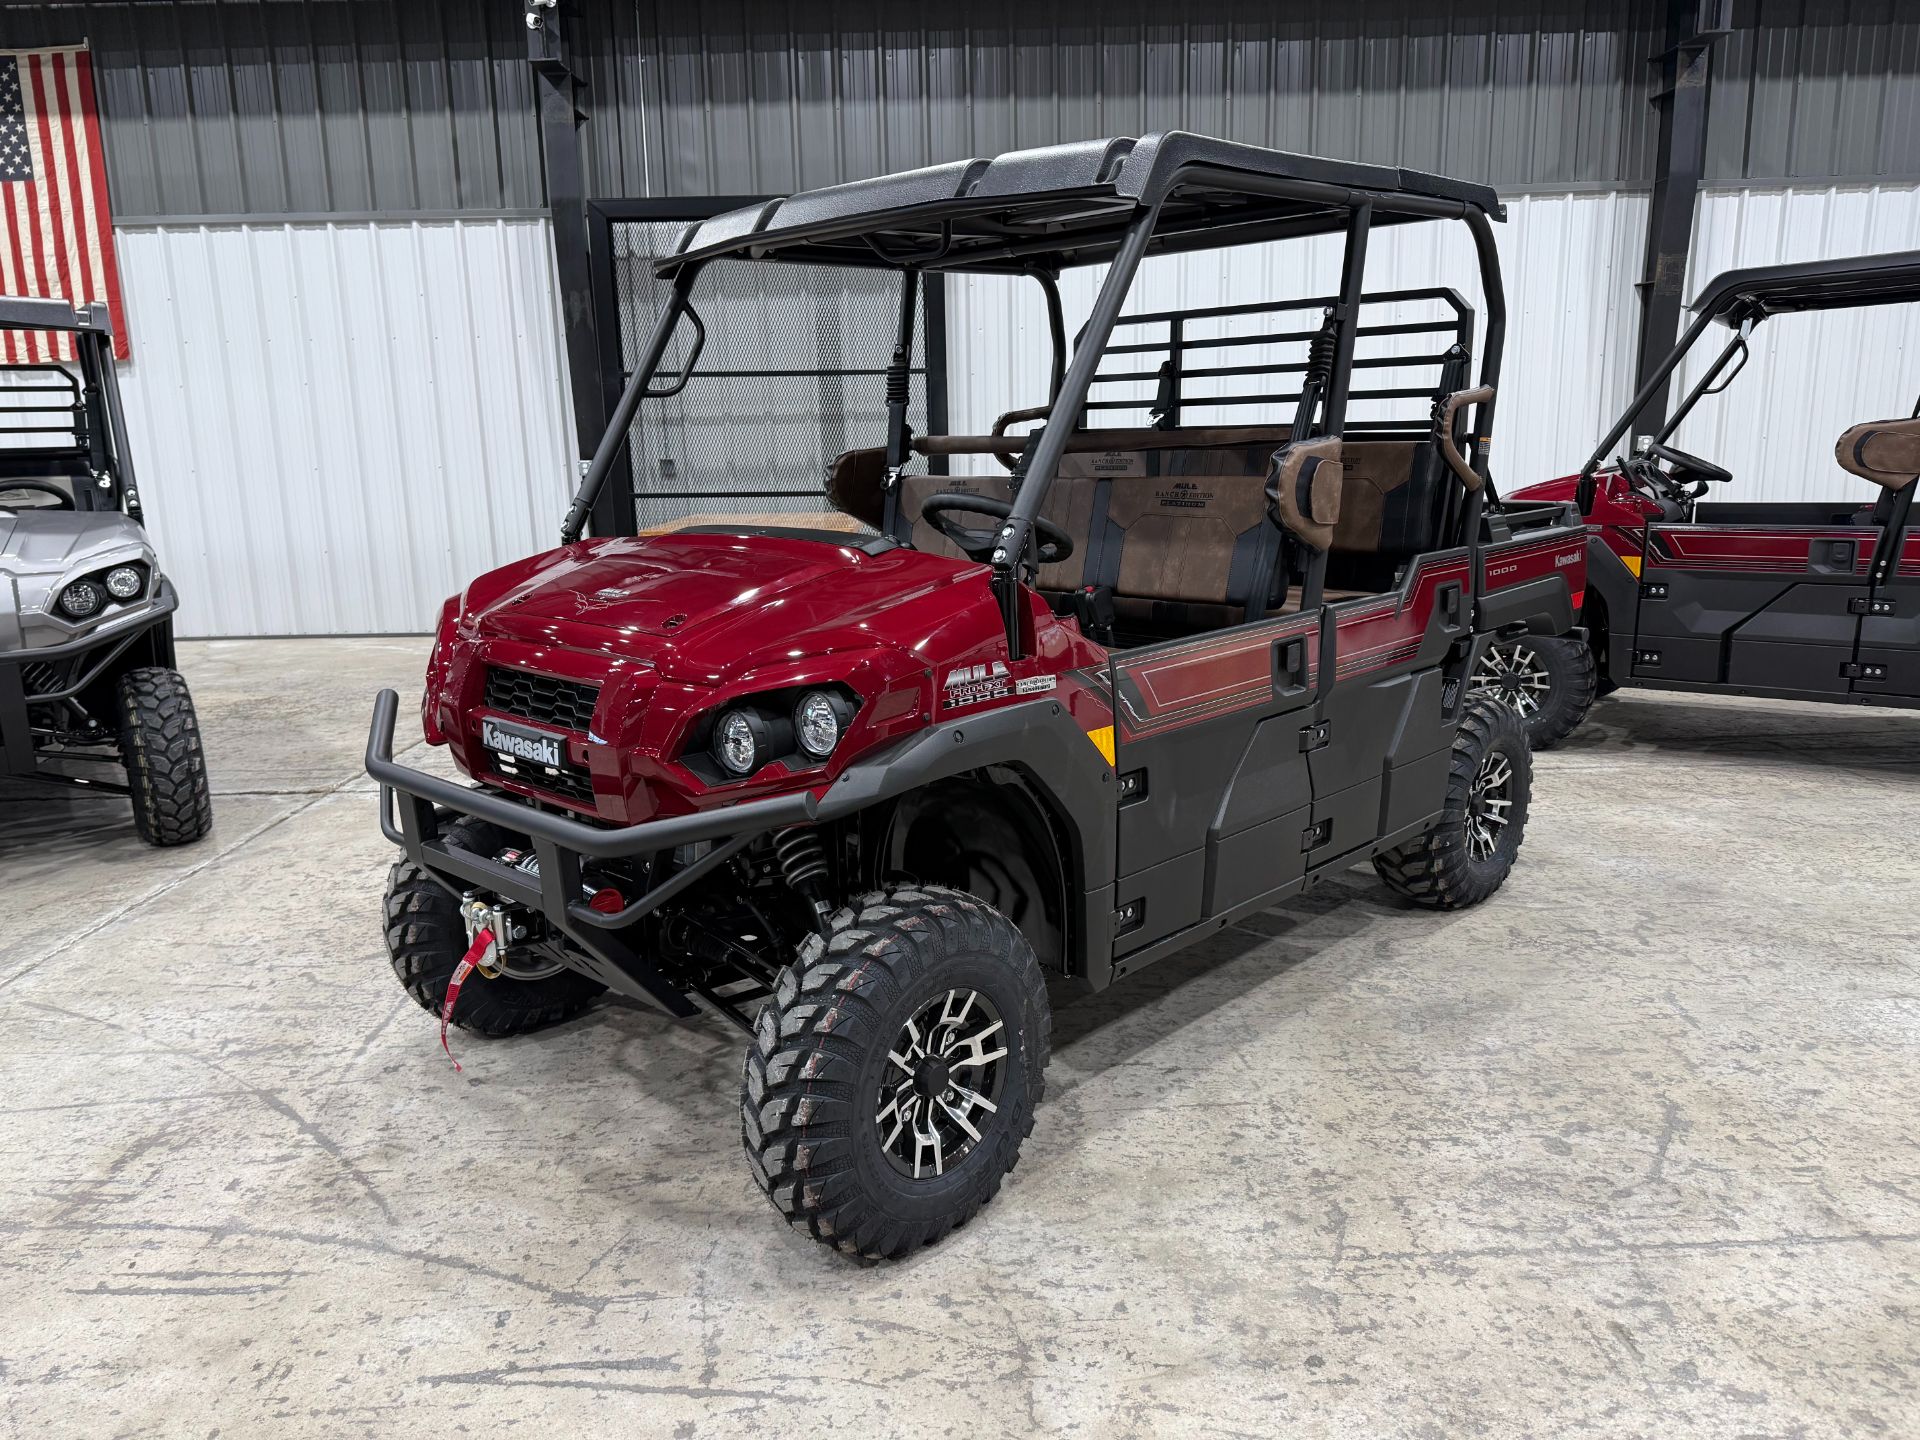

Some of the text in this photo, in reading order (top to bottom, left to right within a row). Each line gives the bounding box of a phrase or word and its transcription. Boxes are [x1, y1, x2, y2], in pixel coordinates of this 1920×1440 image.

[1554, 549, 1582, 568] Kawasaki
[1489, 565, 1518, 577] 1000
[482, 721, 559, 767] Kawasaki
